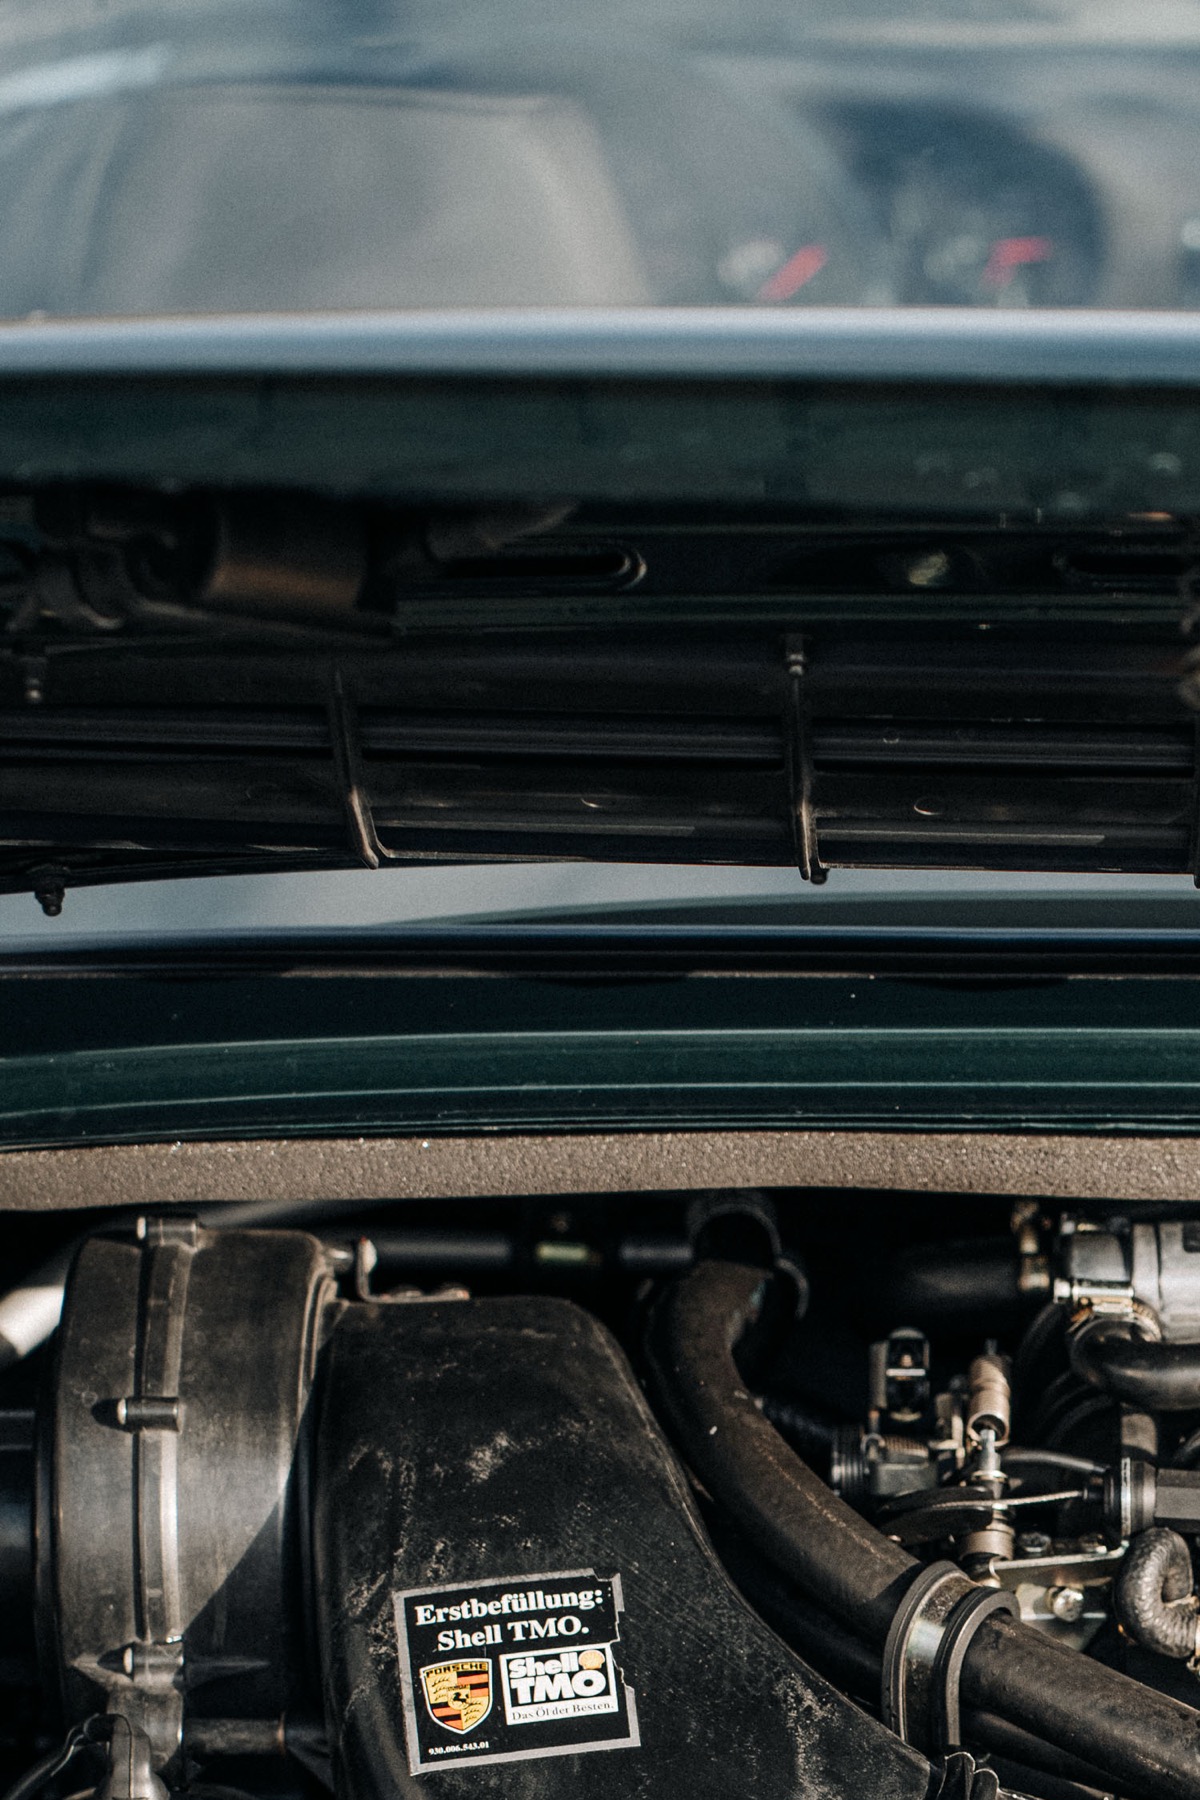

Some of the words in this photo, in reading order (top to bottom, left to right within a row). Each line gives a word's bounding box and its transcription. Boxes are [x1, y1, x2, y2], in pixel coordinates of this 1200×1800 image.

[414, 1589, 603, 1626] Erstbefüllung:
[437, 1623, 502, 1651] Shell
[507, 1615, 590, 1642] TMO.
[426, 1663, 487, 1677] PORSCHE
[509, 1652, 579, 1678] Shell
[510, 1670, 606, 1704] TMO
[512, 1712, 533, 1720] Das
[536, 1706, 549, 1716] Öl
[553, 1707, 569, 1715] der
[573, 1702, 614, 1712] Besten.
